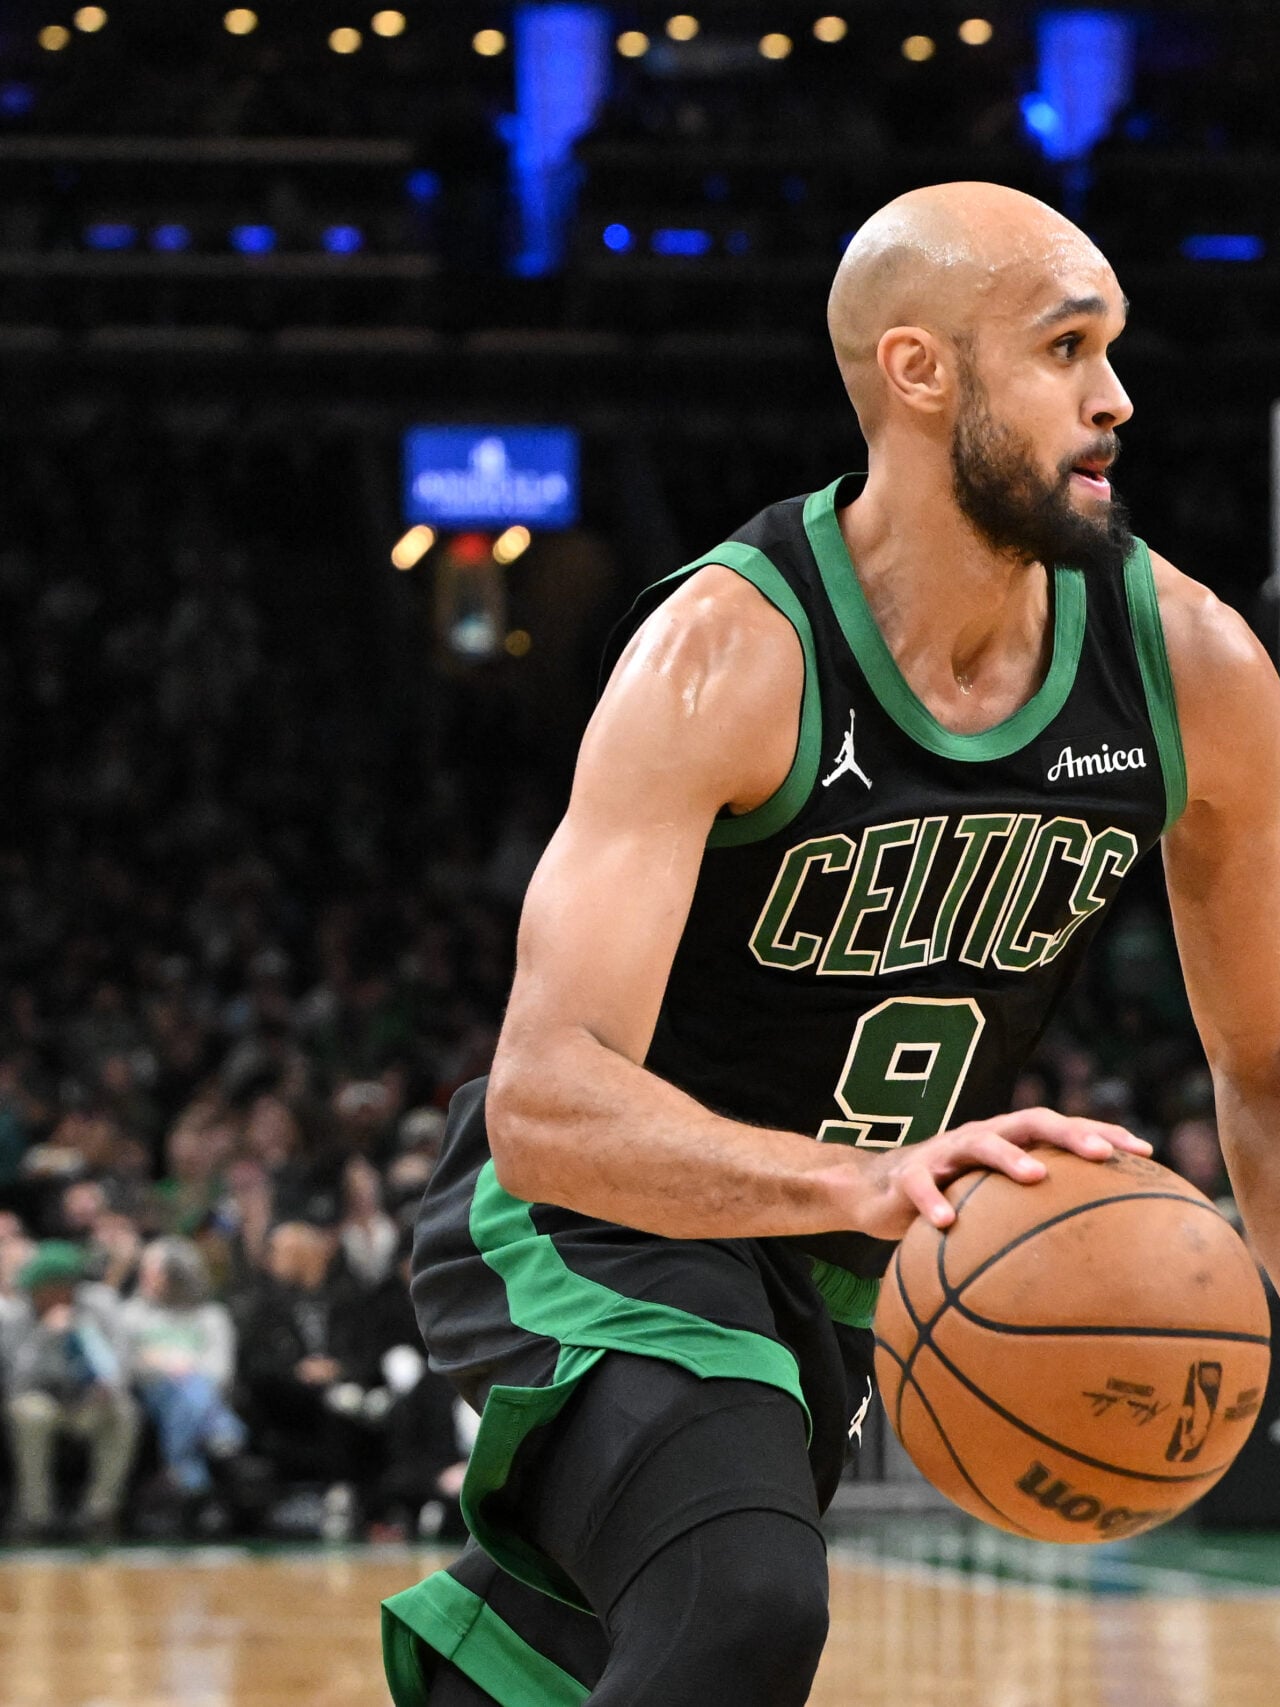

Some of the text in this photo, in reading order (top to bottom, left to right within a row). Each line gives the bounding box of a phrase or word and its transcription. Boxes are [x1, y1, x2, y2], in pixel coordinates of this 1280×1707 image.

[1047, 743, 1147, 782] Amica
[748, 813, 1138, 977] CELTICS
[816, 996, 986, 1150] 9
